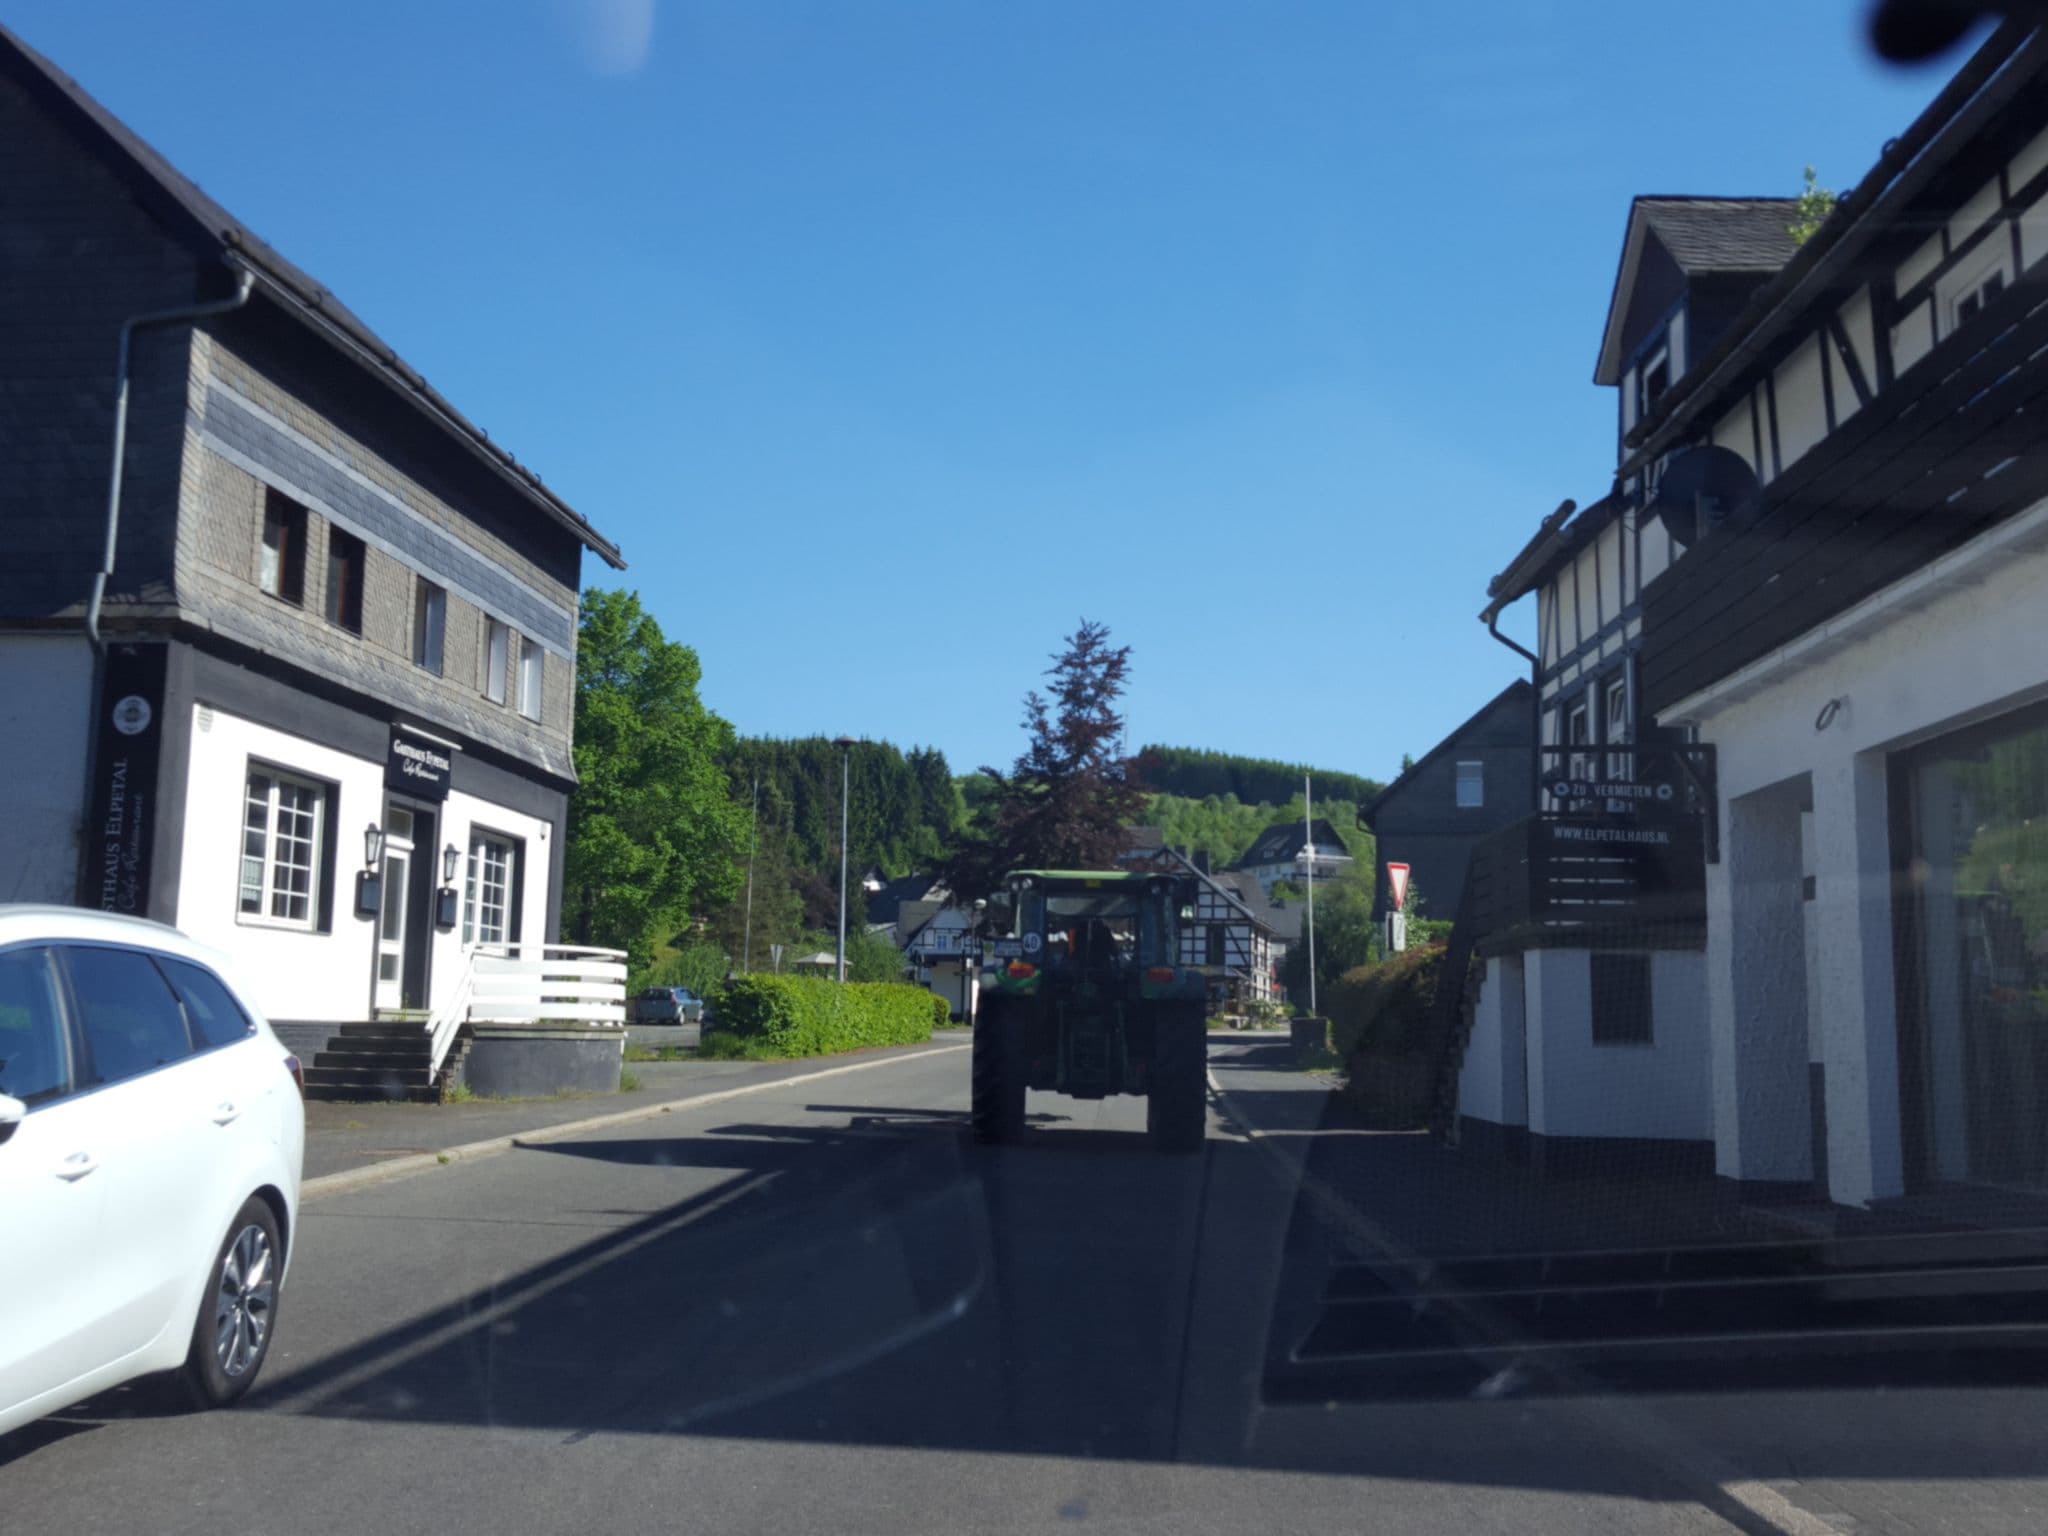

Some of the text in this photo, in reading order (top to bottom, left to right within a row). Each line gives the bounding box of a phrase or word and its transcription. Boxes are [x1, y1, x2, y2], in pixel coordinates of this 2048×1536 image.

[1594, 784, 1652, 798] VERMIETEN
[102, 757, 128, 912] STHAUS ELPETAL
[1024, 935, 1038, 949] 40
